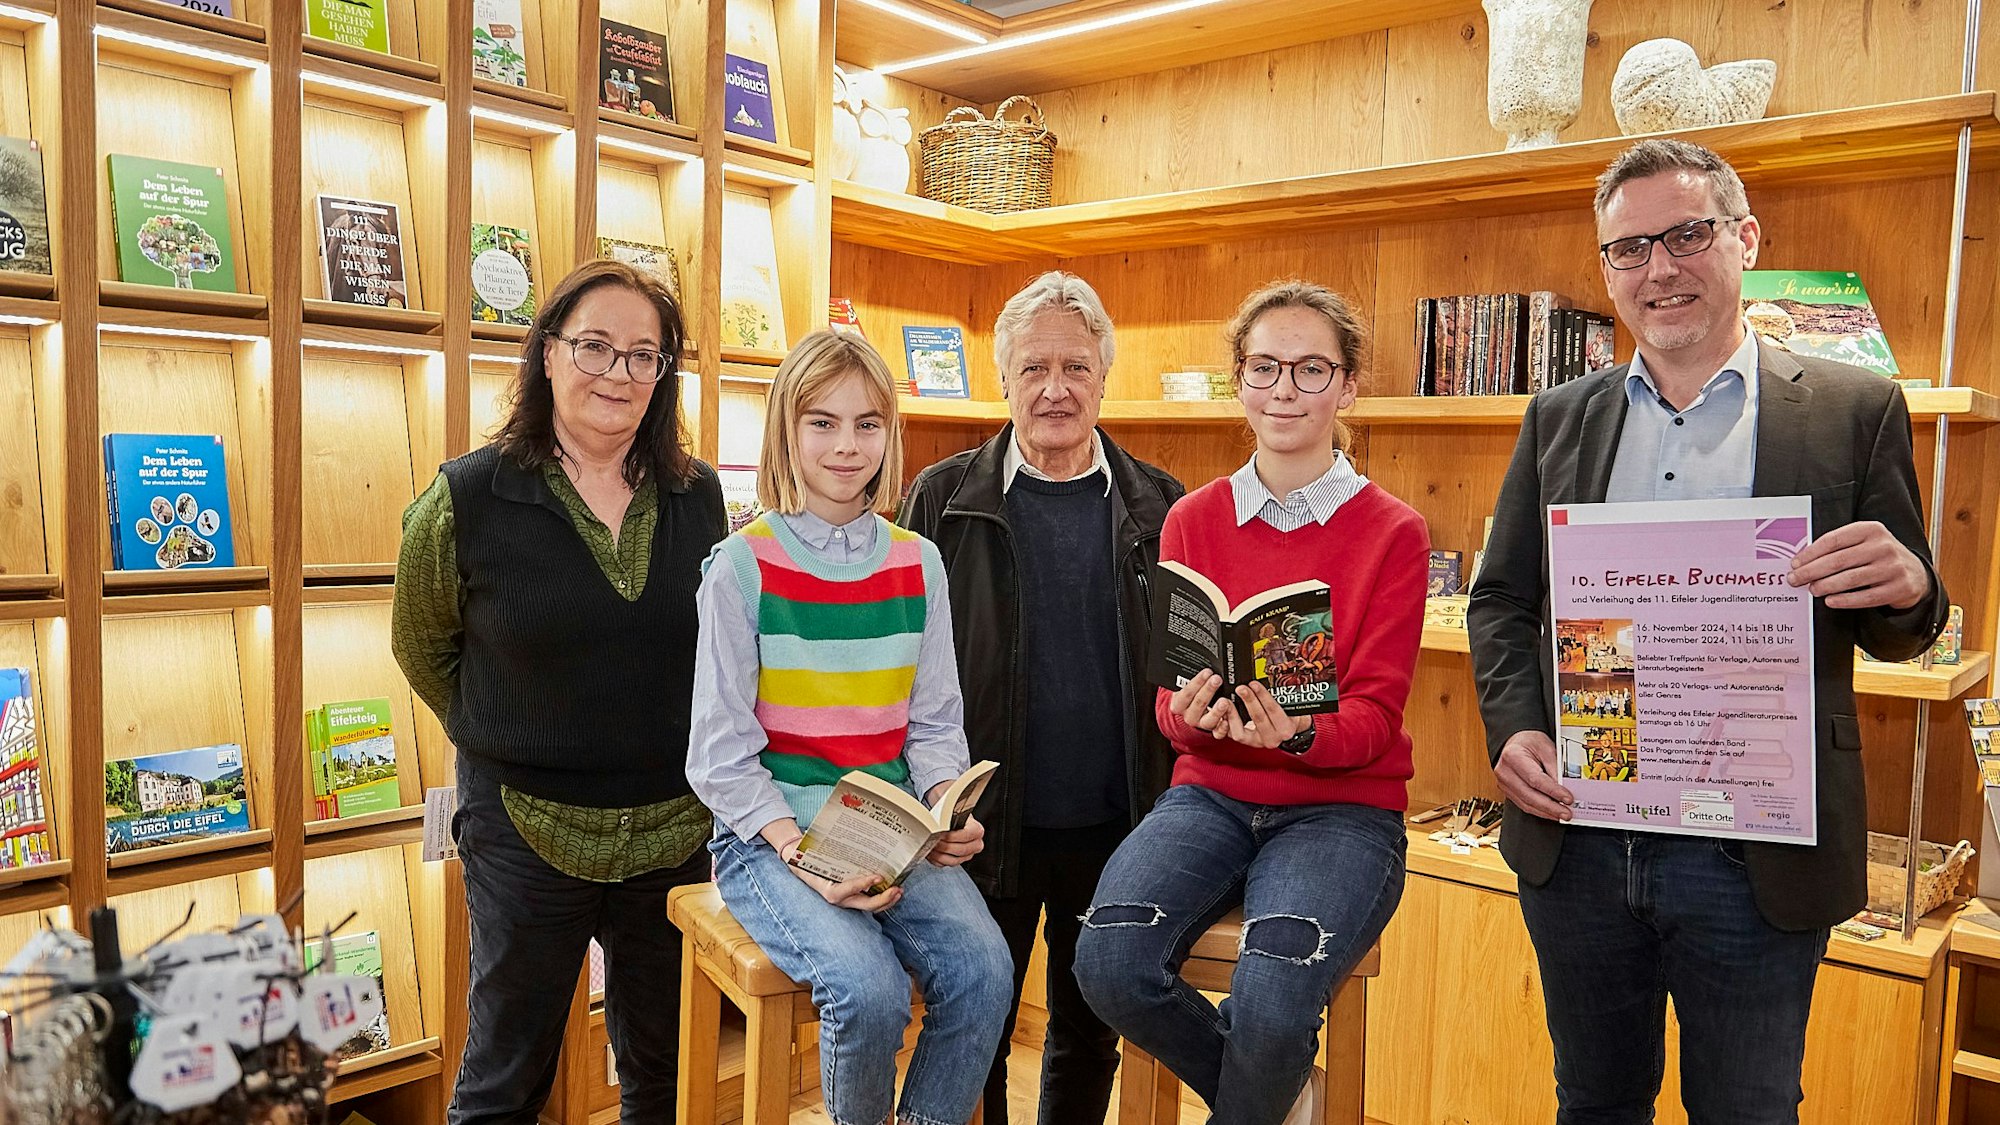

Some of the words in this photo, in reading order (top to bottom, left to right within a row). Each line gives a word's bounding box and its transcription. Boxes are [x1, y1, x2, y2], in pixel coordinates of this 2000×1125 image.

[323, 0, 342, 12] DIE
[345, 5, 371, 18] MAN
[321, 9, 374, 28] GESEHEN
[329, 21, 368, 37] HABEN
[335, 33, 364, 46] MUSS
[143, 179, 168, 192] Dem
[171, 184, 203, 196] Leben
[139, 191, 158, 201] auf
[161, 194, 180, 204] der
[183, 196, 209, 208] Spur
[354, 215, 368, 226] 111
[326, 227, 366, 240] DINGE
[367, 230, 398, 245] ÜBER
[342, 244, 387, 258] PFERDE
[340, 260, 362, 270] DIE
[364, 263, 392, 275] MAN
[476, 262, 524, 276] Psychoaktive
[345, 276, 390, 289] WISSEN
[1844, 283, 1860, 294] in
[479, 283, 496, 293] Pilze
[507, 287, 524, 296] Tiere
[354, 292, 386, 304] MUSS
[143, 456, 167, 466] Dem
[170, 456, 202, 466] Leben
[139, 467, 158, 477] auf
[160, 468, 179, 477] der
[182, 468, 208, 479] Spur
[1572, 576, 1595, 587] 10.
[1688, 568, 1785, 586] BUCHMESS
[1590, 595, 1634, 604] Verleihung
[1672, 594, 1698, 603] Eifeler
[1701, 594, 1798, 604] Jugendliteraturpreises
[1701, 624, 1728, 632] 2024,
[1701, 636, 1728, 644] 2024,
[1267, 685, 1297, 697] URZ
[1300, 682, 1330, 693] UND
[1274, 691, 1324, 704] OPFLOS
[330, 706, 364, 715] Abenteuer
[1639, 708, 1676, 717] Verleihung
[1717, 712, 1797, 721] Jugendliteraturpreises
[331, 713, 377, 727] Eifelsteig
[334, 729, 375, 743] Wanderführer
[1708, 778, 1760, 787] Ausstellungen)
[1689, 812, 1713, 821] Dritte
[1716, 814, 1734, 822] Orte
[131, 822, 170, 836] DURCH
[173, 819, 192, 829] DIE
[195, 814, 225, 826] EIFEL
